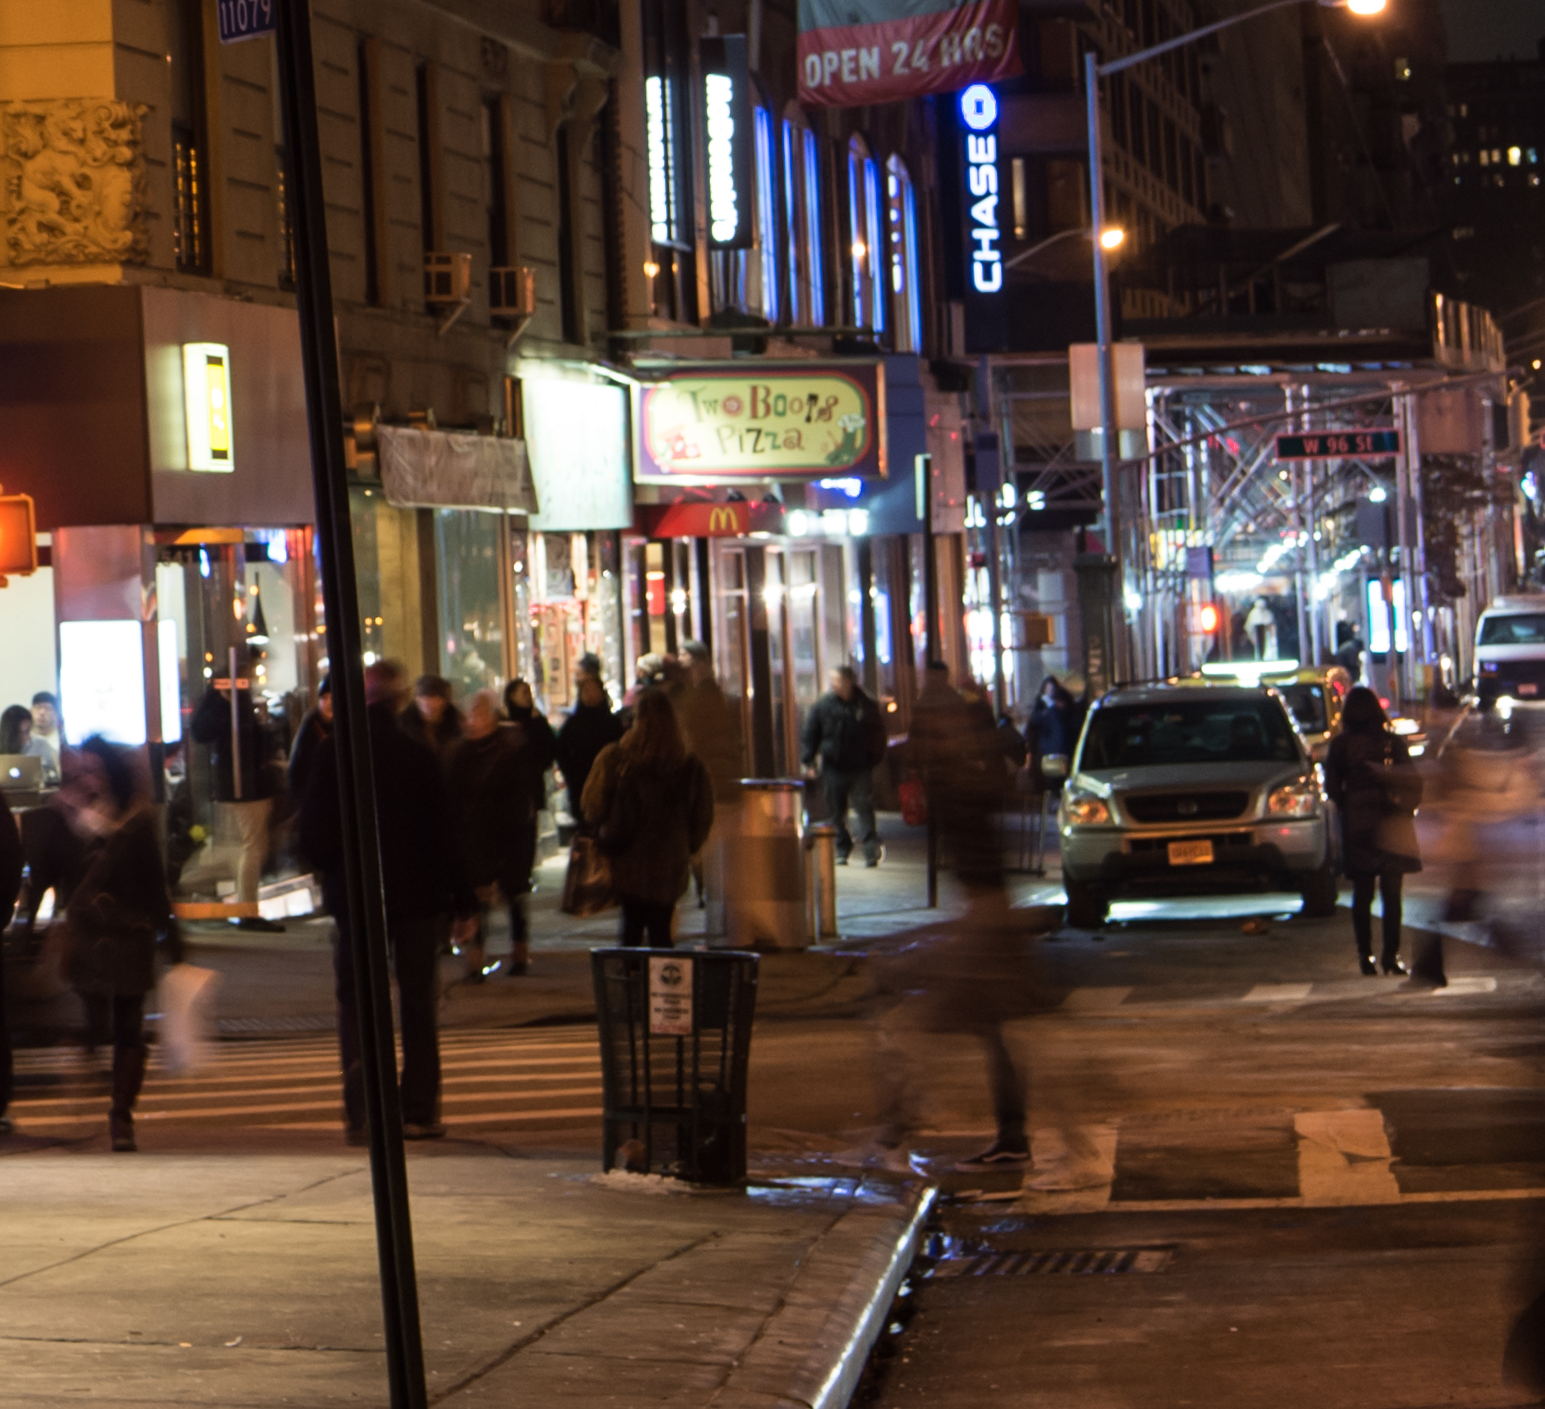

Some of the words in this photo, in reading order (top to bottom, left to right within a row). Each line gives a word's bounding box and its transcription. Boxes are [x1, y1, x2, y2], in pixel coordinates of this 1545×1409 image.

[804, 46, 881, 89] OPEN
[891, 40, 929, 77] 24
[967, 133, 1002, 293] CHASE
[1302, 437, 1320, 454] W
[1326, 436, 1349, 454] 96
[1355, 433, 1373, 452] St
